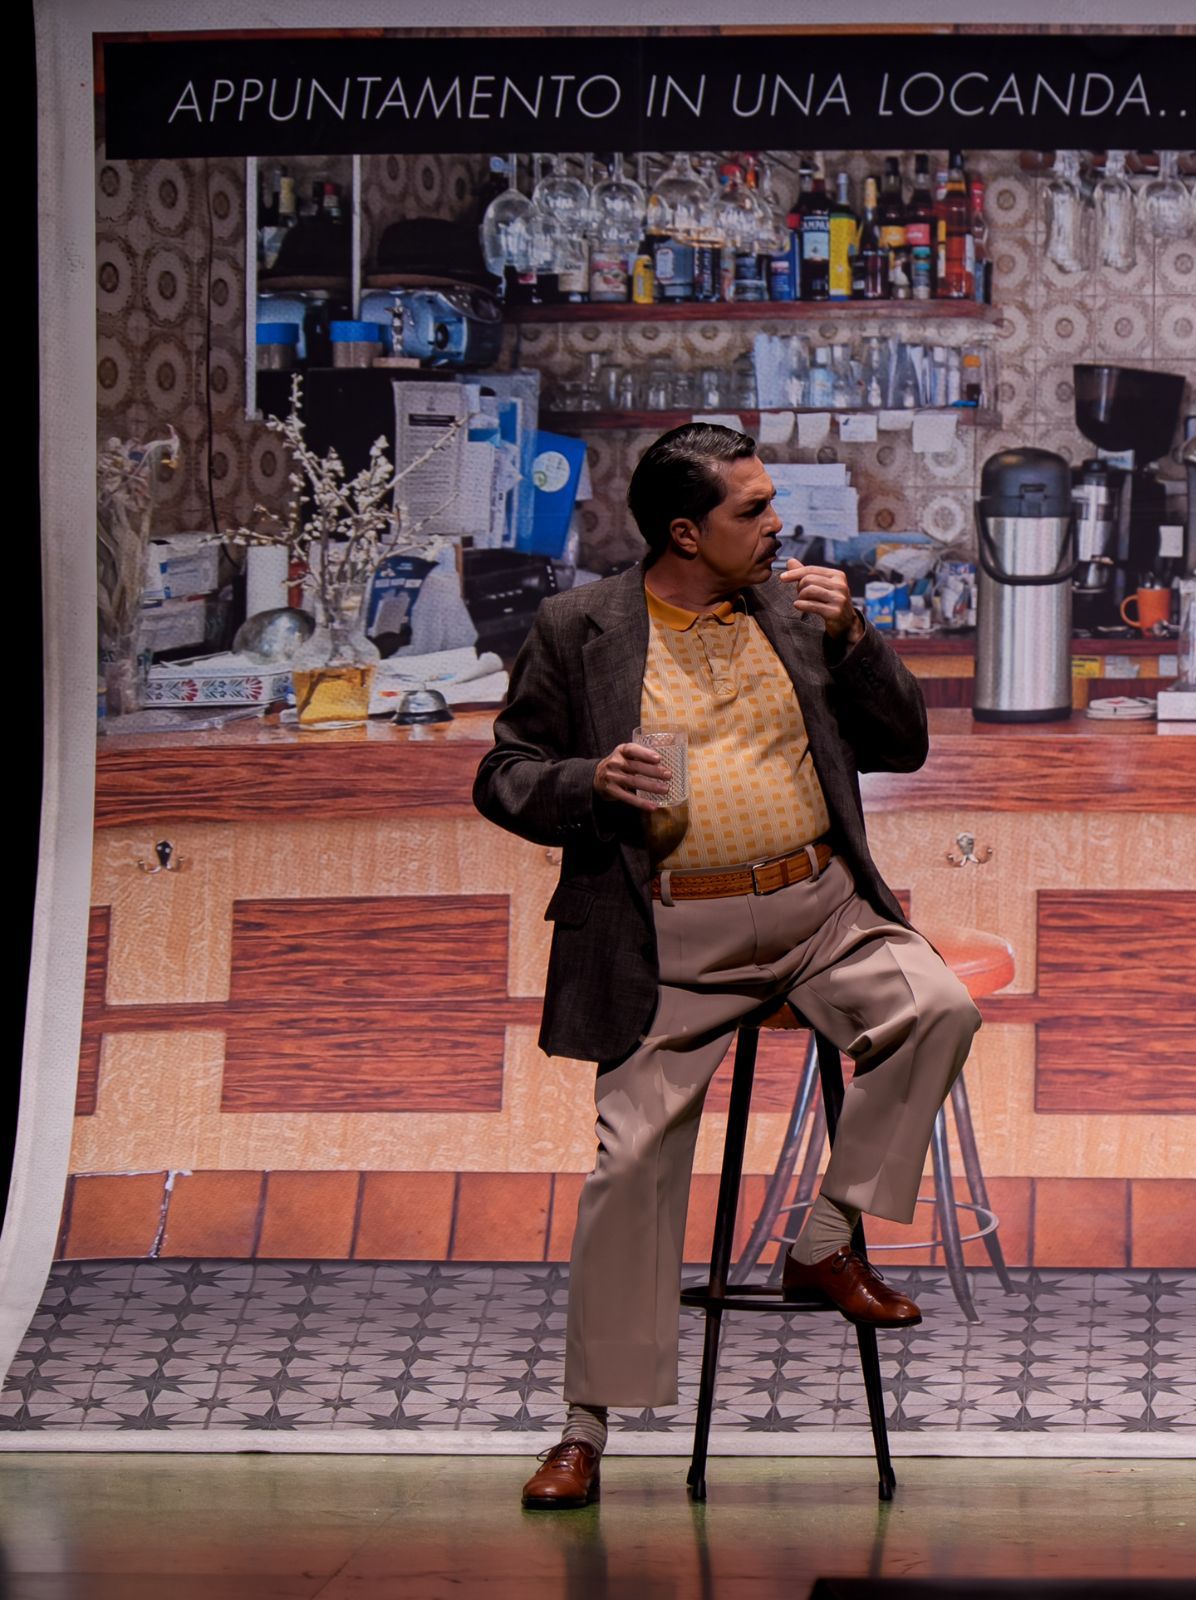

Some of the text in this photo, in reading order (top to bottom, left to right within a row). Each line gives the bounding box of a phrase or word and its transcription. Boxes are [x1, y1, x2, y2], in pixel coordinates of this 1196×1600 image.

[168, 75, 620, 122] APPUNTAMENTO
[647, 74, 705, 116] IN
[732, 73, 850, 116] UNA
